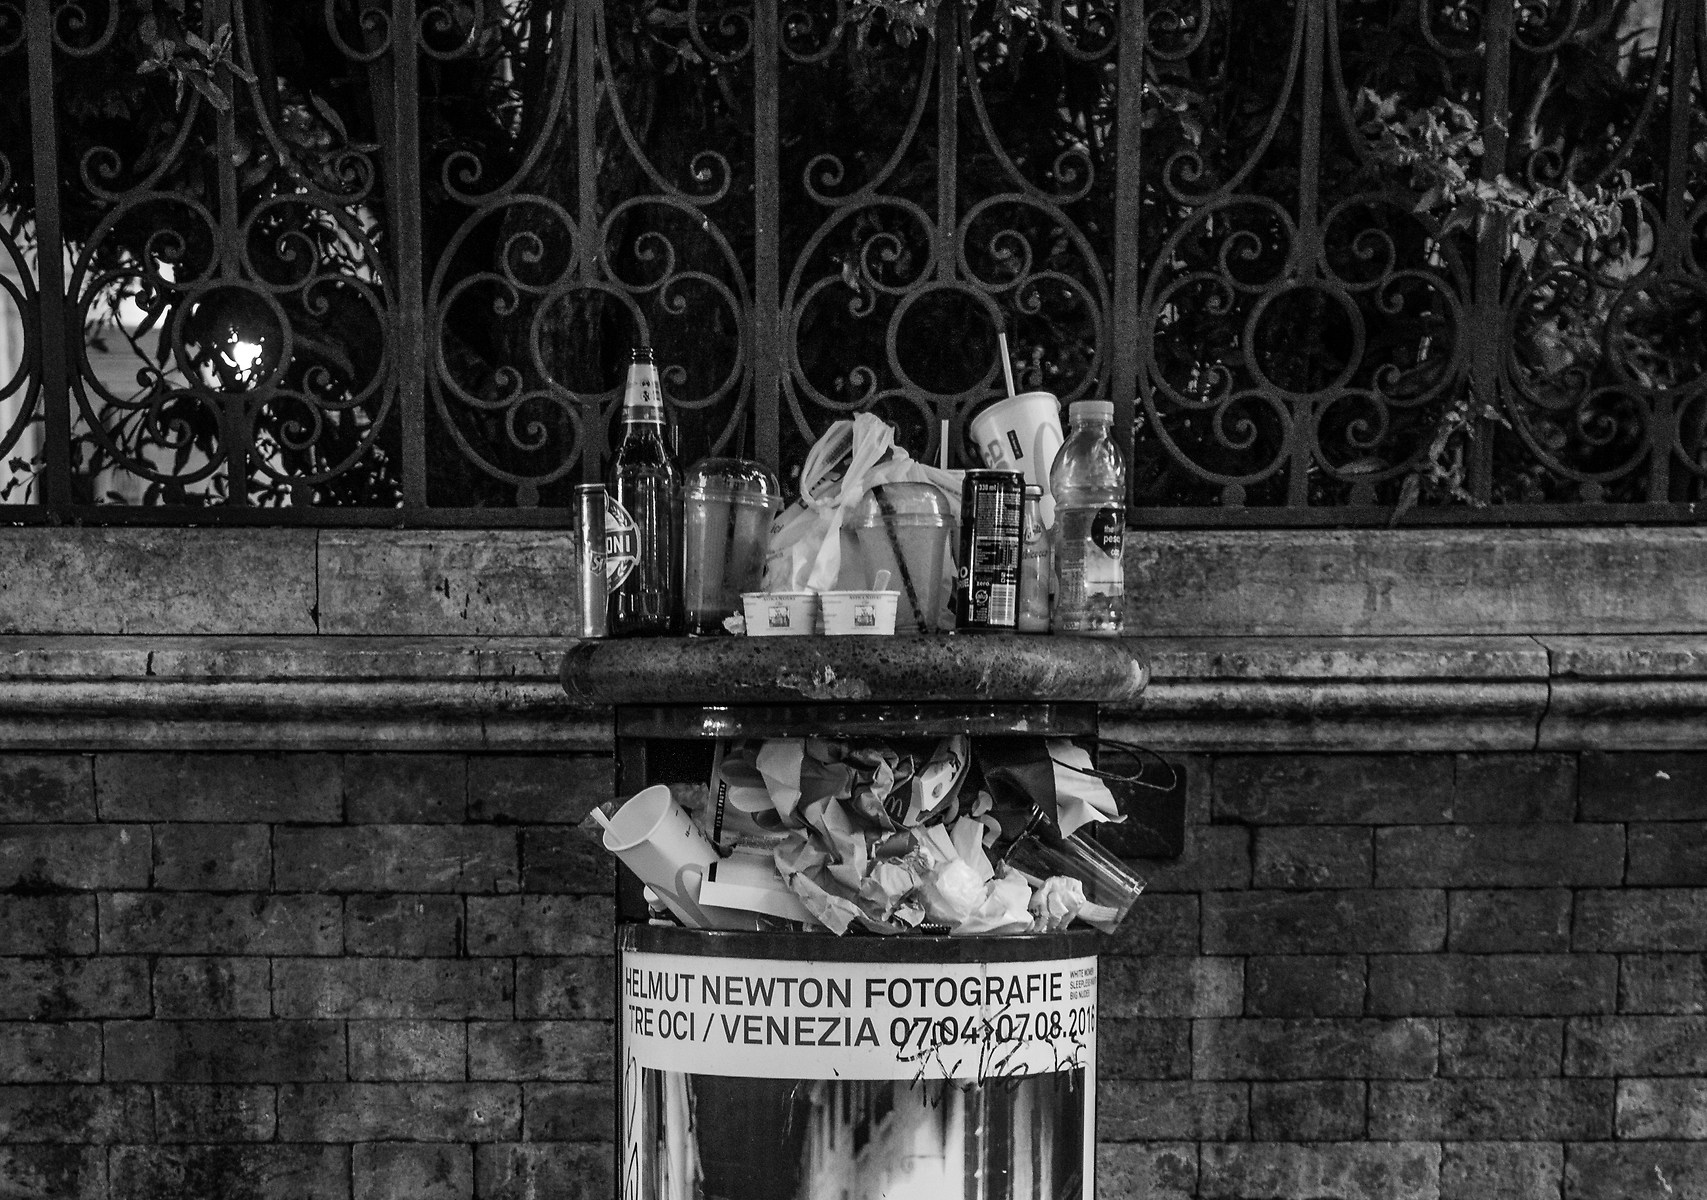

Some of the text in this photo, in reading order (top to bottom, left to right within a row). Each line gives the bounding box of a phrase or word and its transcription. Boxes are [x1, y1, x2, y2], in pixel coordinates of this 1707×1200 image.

[606, 534, 631, 554] ONI
[625, 966, 1063, 1009] HELMUT NEWTON FOTOGRAFIE
[628, 1004, 654, 1037] TRE
[658, 1009, 695, 1041] OCI
[702, 1012, 715, 1043] /
[720, 1013, 881, 1047] VENEZIA
